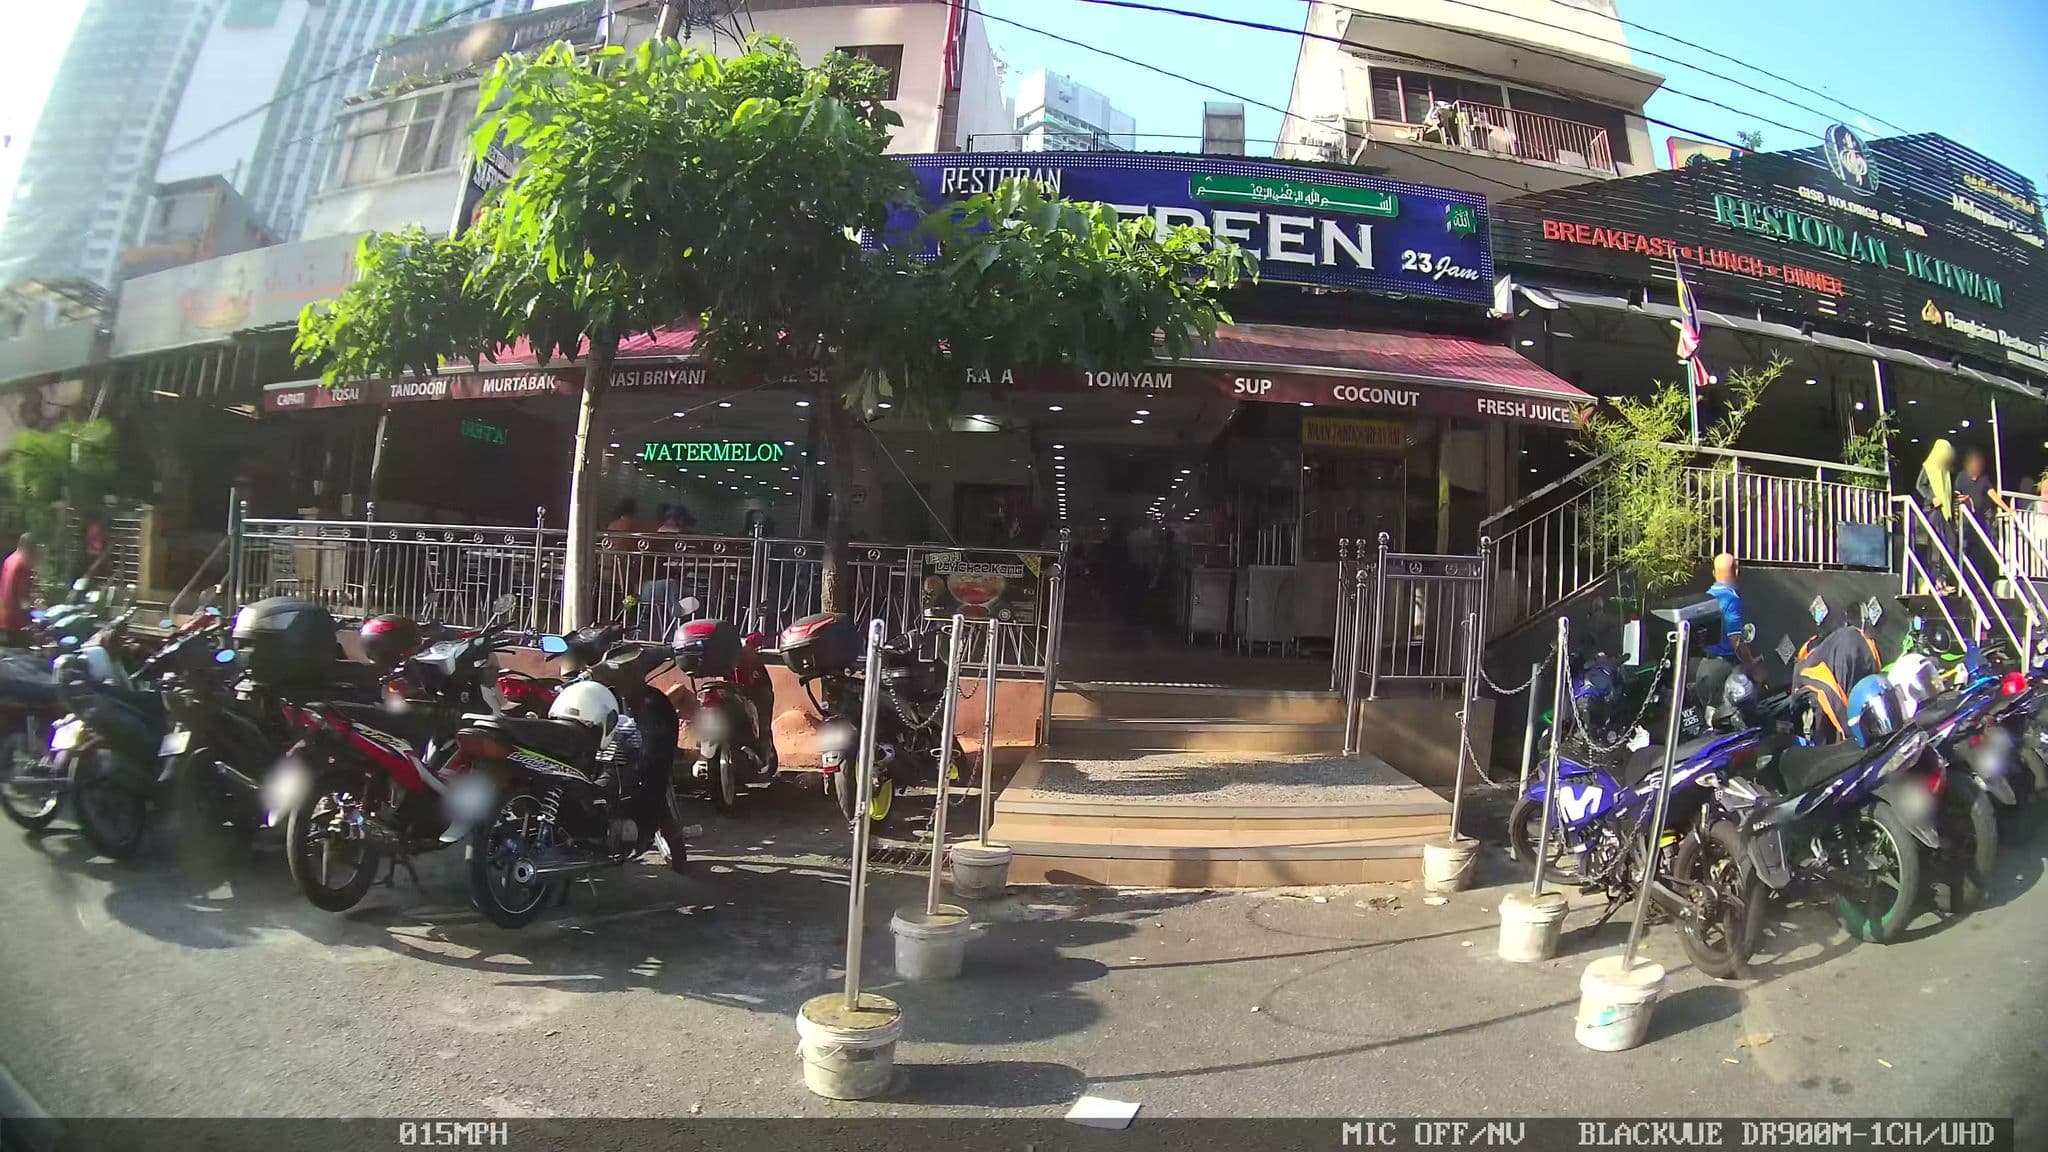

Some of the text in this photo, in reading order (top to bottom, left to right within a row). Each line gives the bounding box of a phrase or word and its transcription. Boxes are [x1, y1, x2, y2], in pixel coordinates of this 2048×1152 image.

[1402, 249, 1479, 280] 23 Jam
[1542, 219, 1845, 298] BREAKFAST LUNCH DINNER
[1713, 194, 2005, 310] RESTORAN IKHWAN
[331, 388, 360, 401] TOSAI
[390, 380, 447, 398] TANDOORI
[482, 374, 556, 393] MURTABAK
[643, 369, 706, 386] BRIYANI
[1085, 370, 1173, 390] TOMYAM
[1234, 378, 1272, 396] SUP
[1332, 385, 1420, 407] COCONUT
[1477, 398, 1526, 418] FRESH
[1529, 404, 1570, 423] JUICE
[643, 442, 784, 462] WATERMELON
